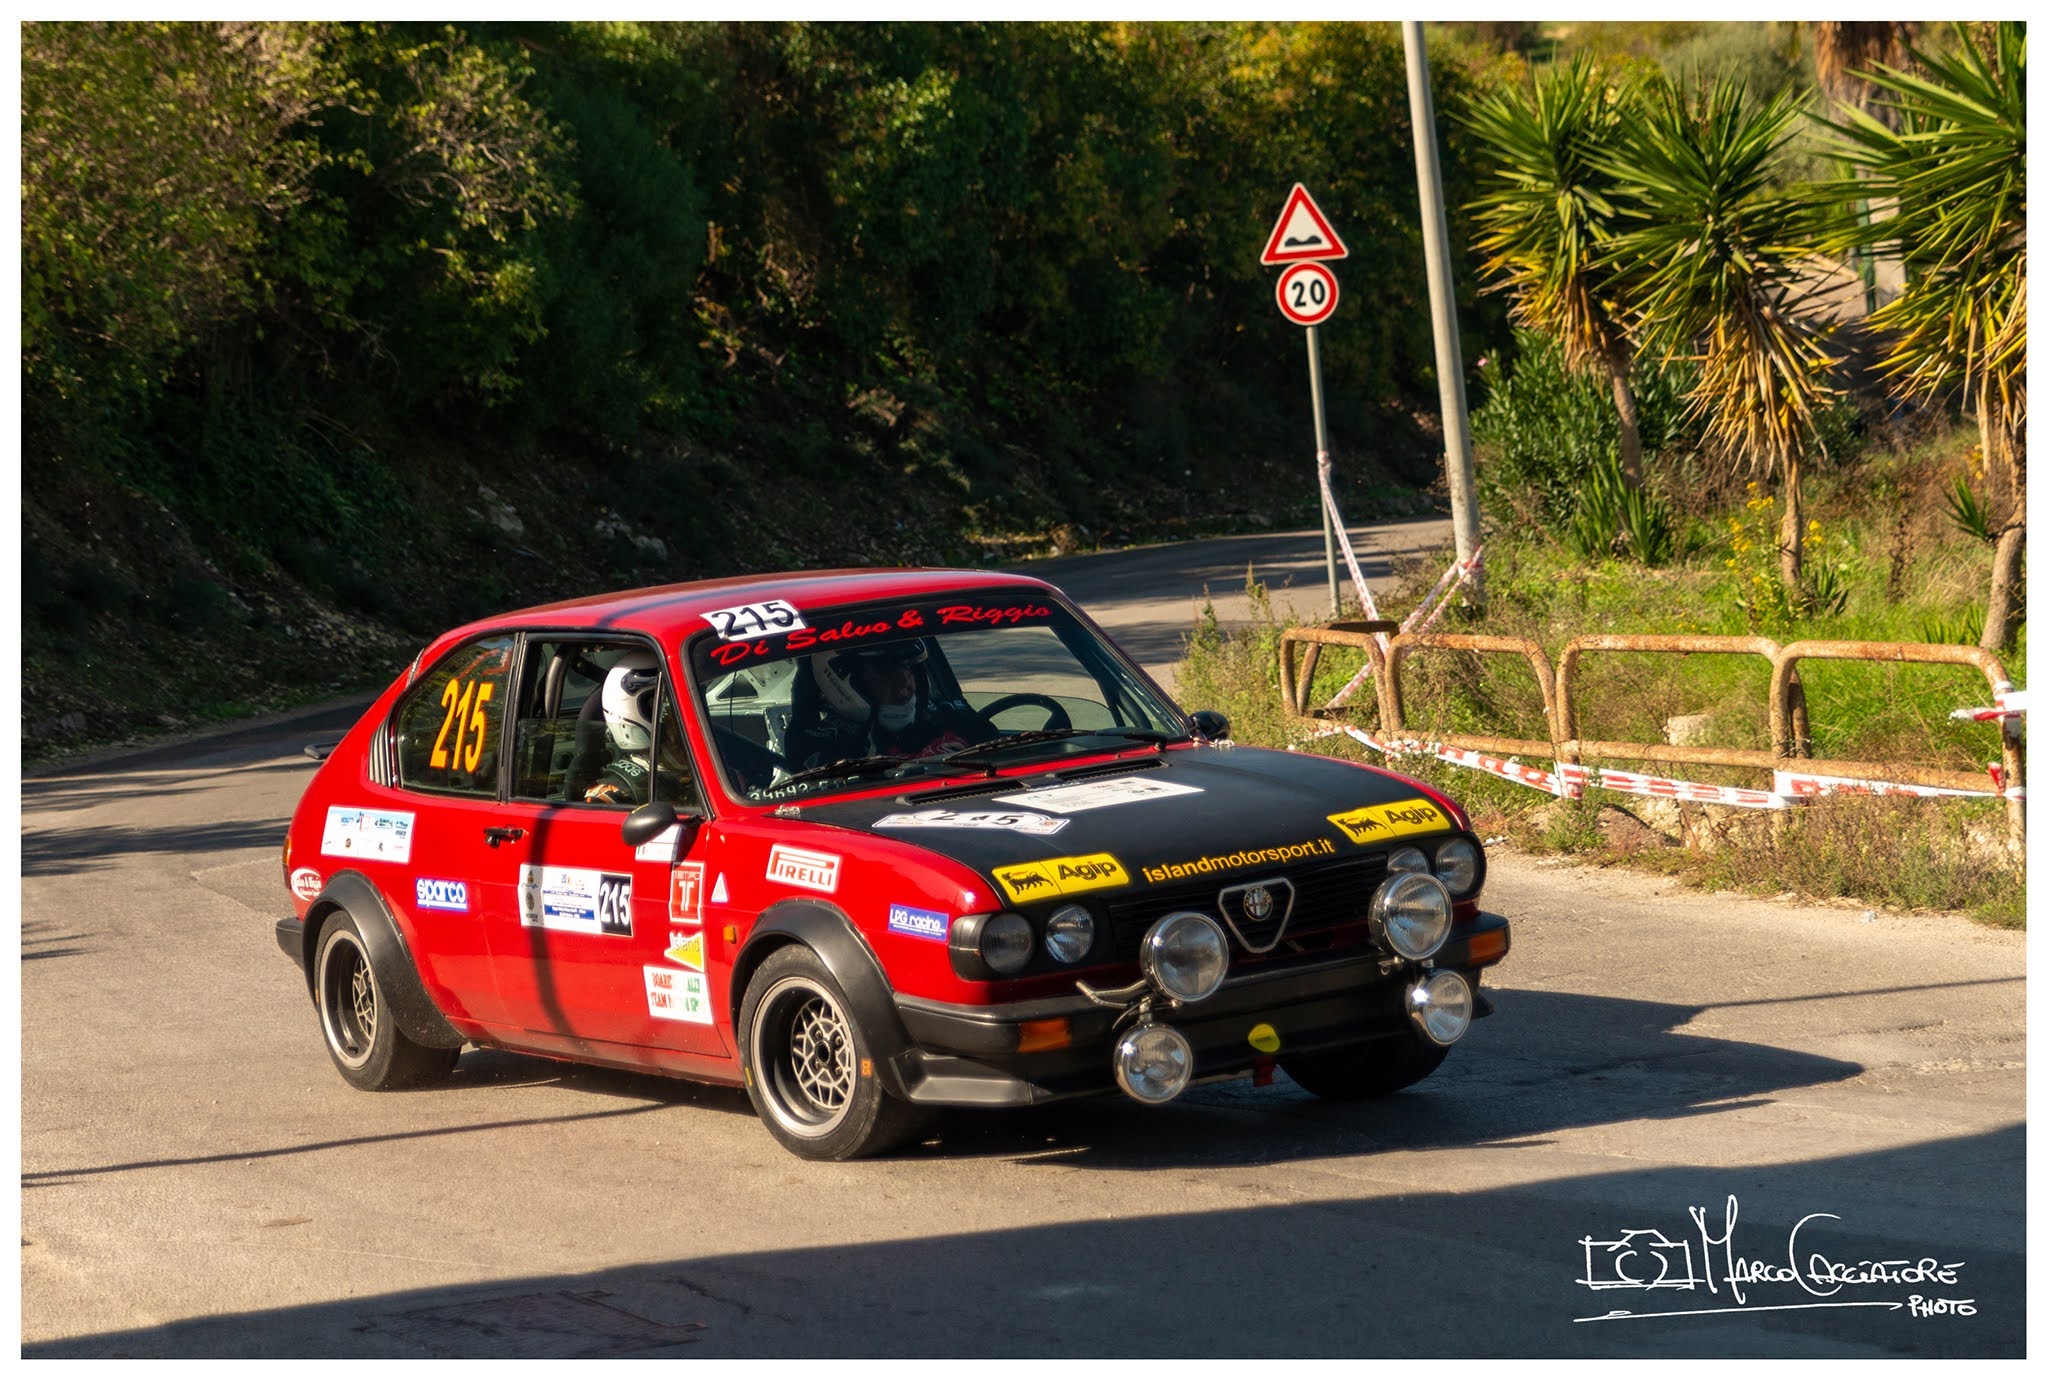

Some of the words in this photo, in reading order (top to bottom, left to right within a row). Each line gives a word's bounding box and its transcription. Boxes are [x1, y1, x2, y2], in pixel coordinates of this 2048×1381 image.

[1292, 279, 1325, 308] 20
[710, 640, 769, 666] Di
[785, 620, 892, 650] Salvo
[897, 609, 924, 628] &
[936, 603, 1052, 625] Riggio
[711, 601, 795, 637] 215
[429, 677, 494, 773] 215
[1383, 804, 1439, 826] Agip
[769, 851, 835, 887] PIRELLI
[1057, 860, 1118, 881] Agip
[1141, 837, 1336, 884] islandmotorsport.it
[416, 878, 467, 908] sparco
[599, 881, 631, 926] 215
[890, 909, 908, 925] LPG
